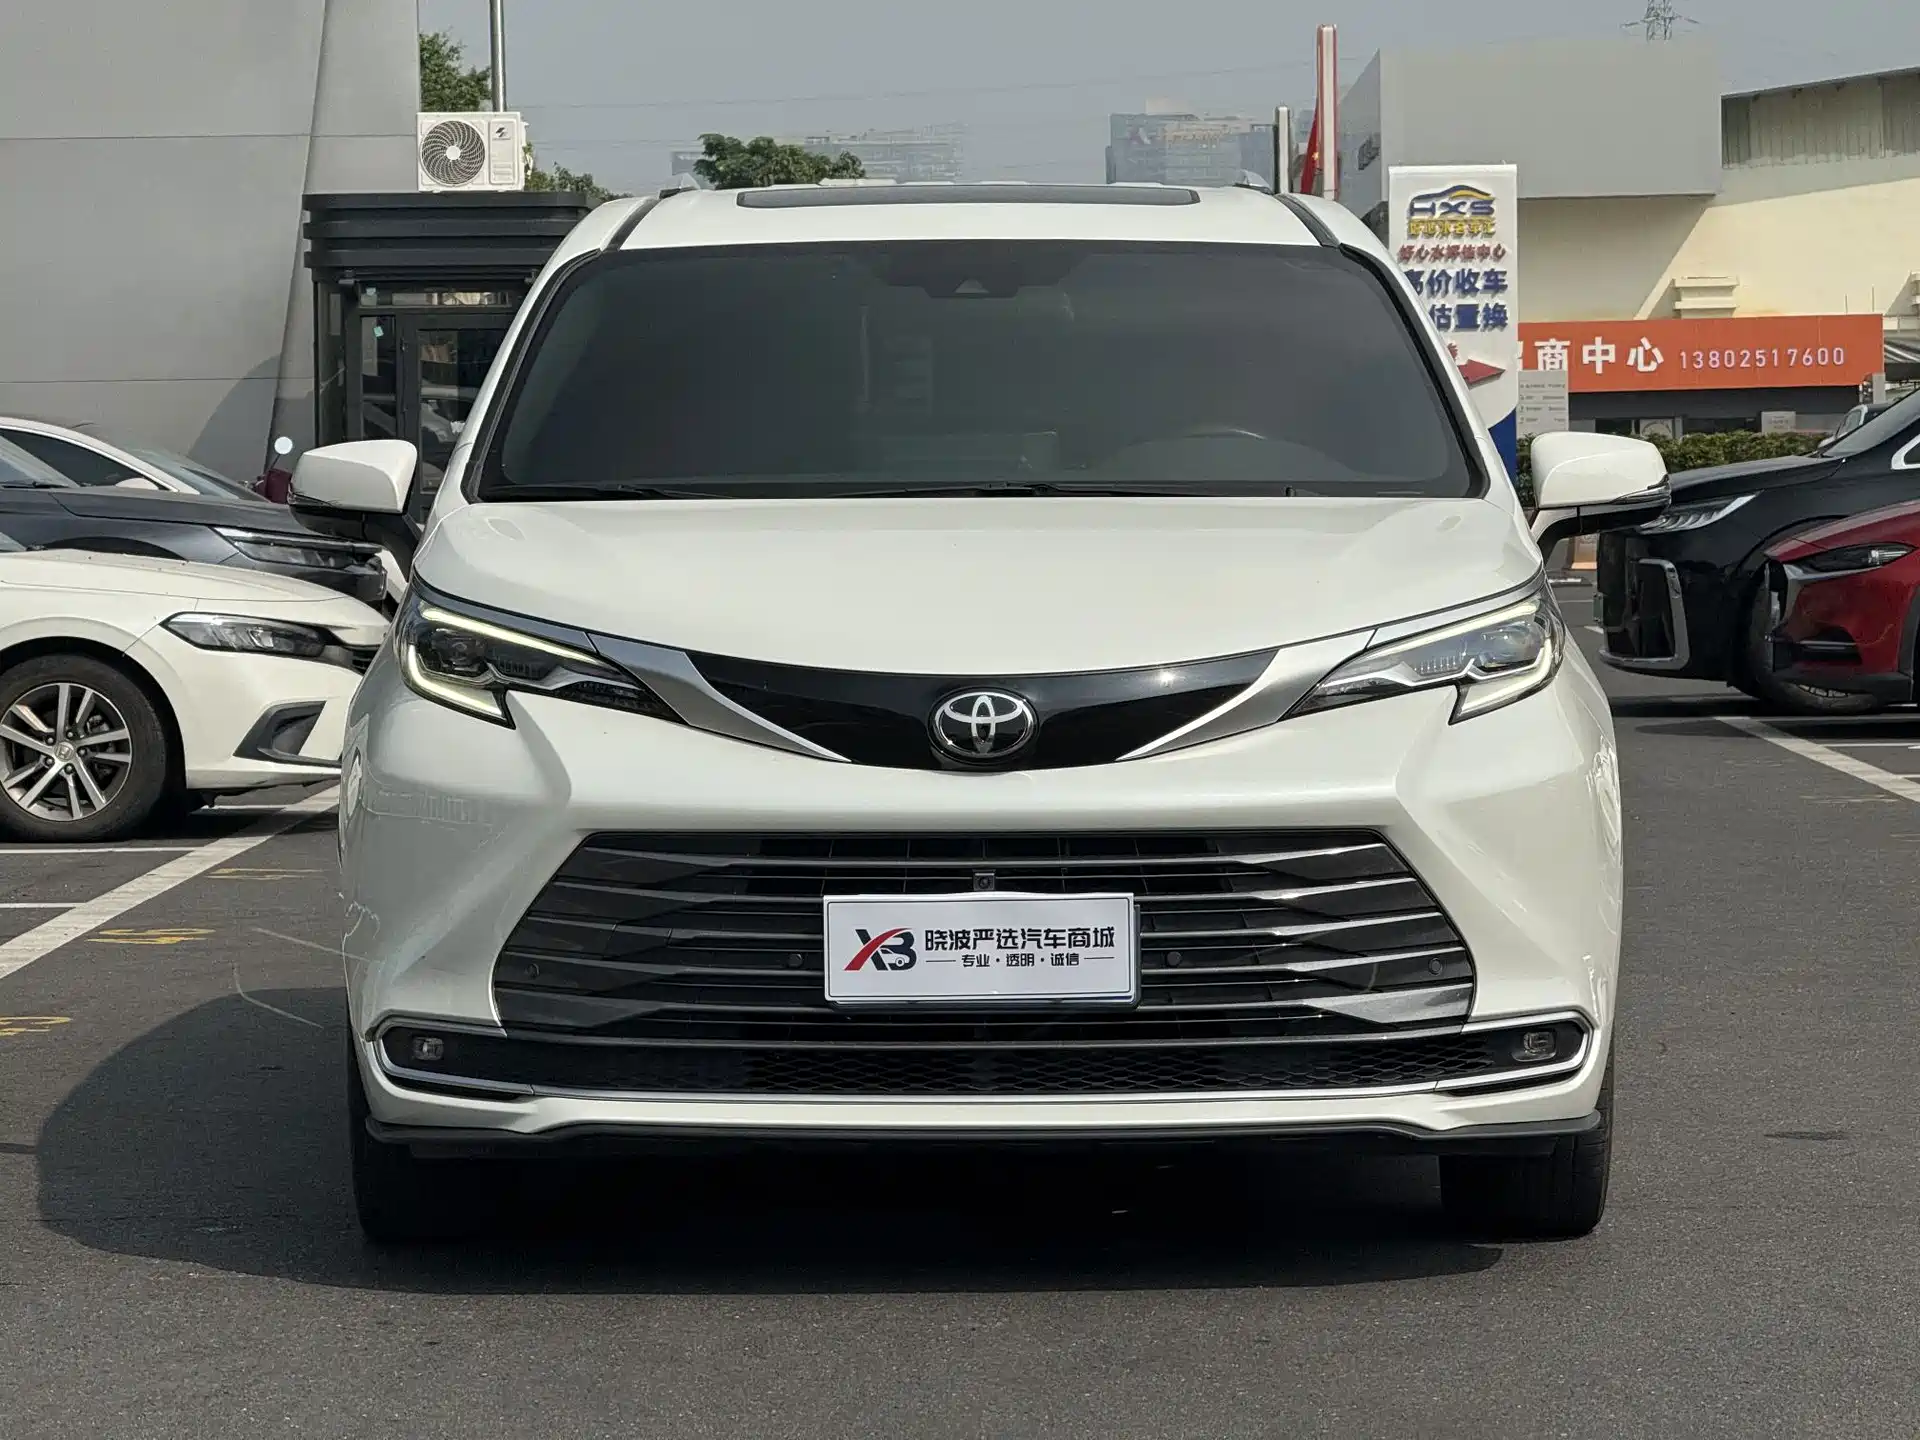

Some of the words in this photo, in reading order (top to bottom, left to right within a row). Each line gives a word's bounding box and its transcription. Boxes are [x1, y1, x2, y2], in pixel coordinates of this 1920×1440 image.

[1518, 336, 1665, 374] 商中心
[1680, 347, 1845, 369] 13802517600
[924, 926, 1115, 951] 晓波严选汽车商城
